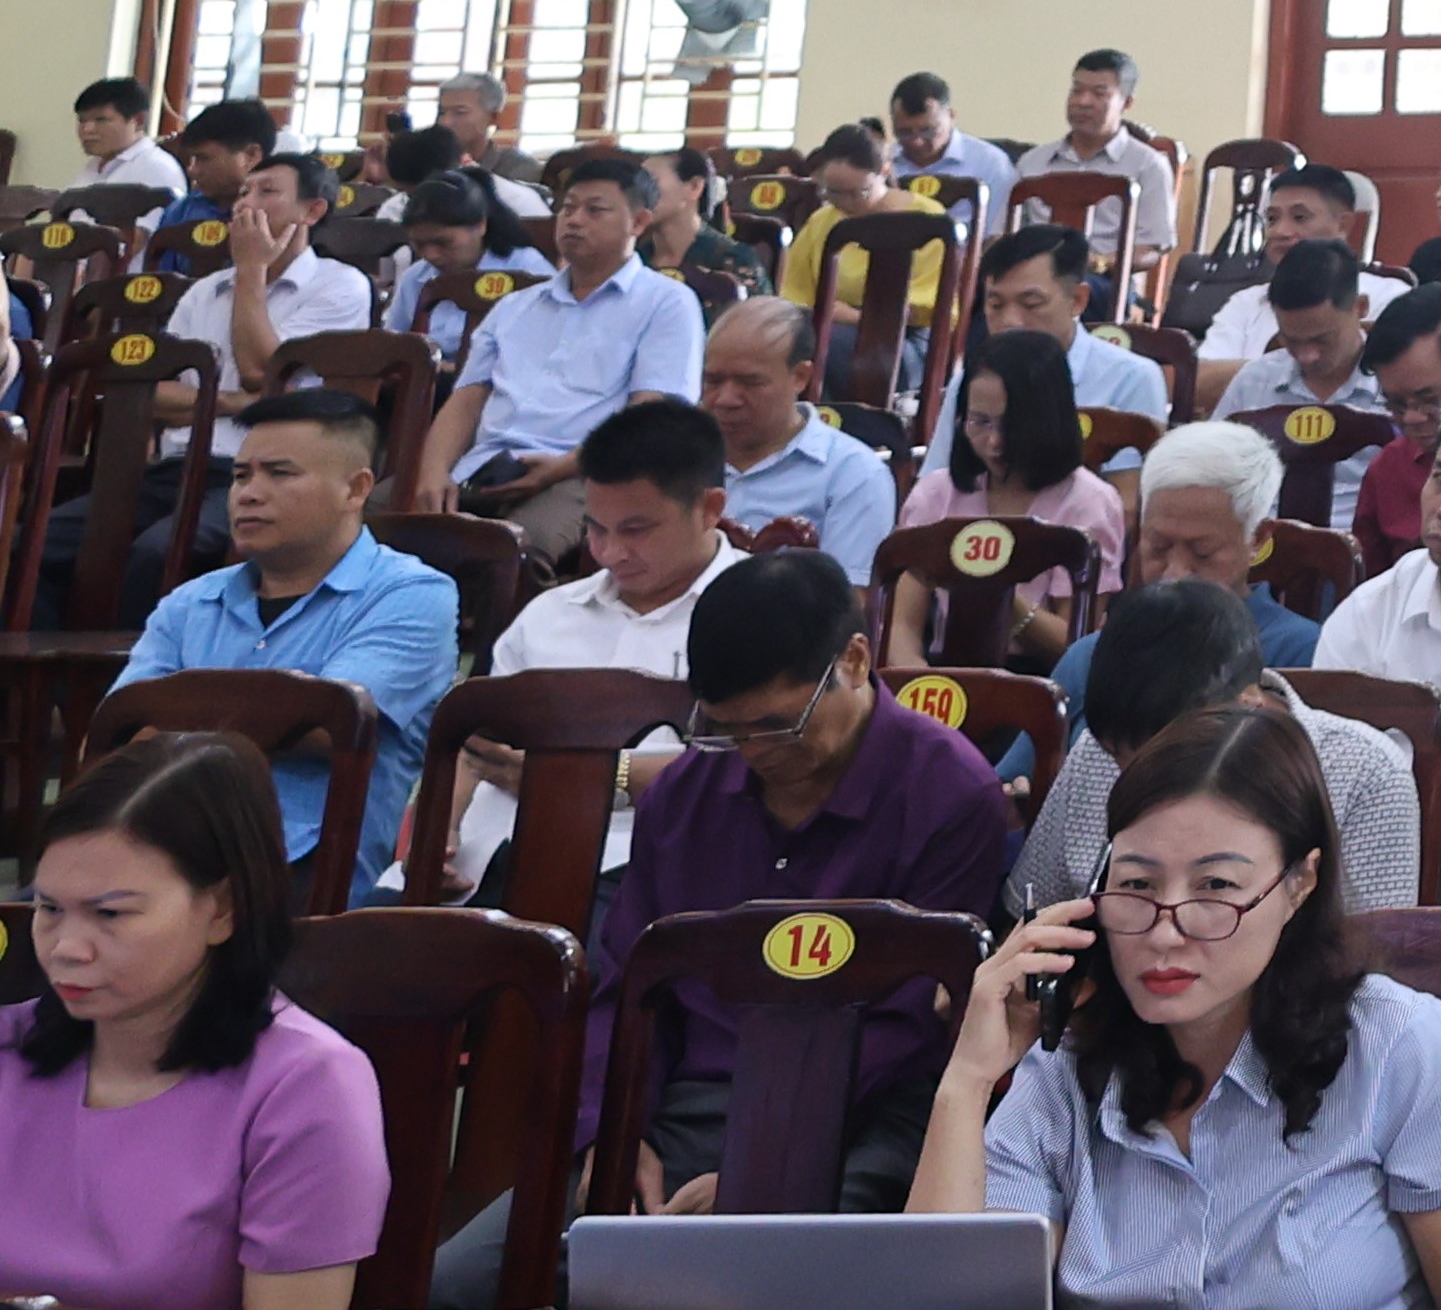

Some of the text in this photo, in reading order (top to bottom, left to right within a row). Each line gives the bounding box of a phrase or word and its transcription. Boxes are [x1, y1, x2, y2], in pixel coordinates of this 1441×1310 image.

[120, 337, 147, 362] 123
[1295, 414, 1322, 437] 111
[964, 536, 1001, 560] 30
[786, 924, 833, 966] 14
